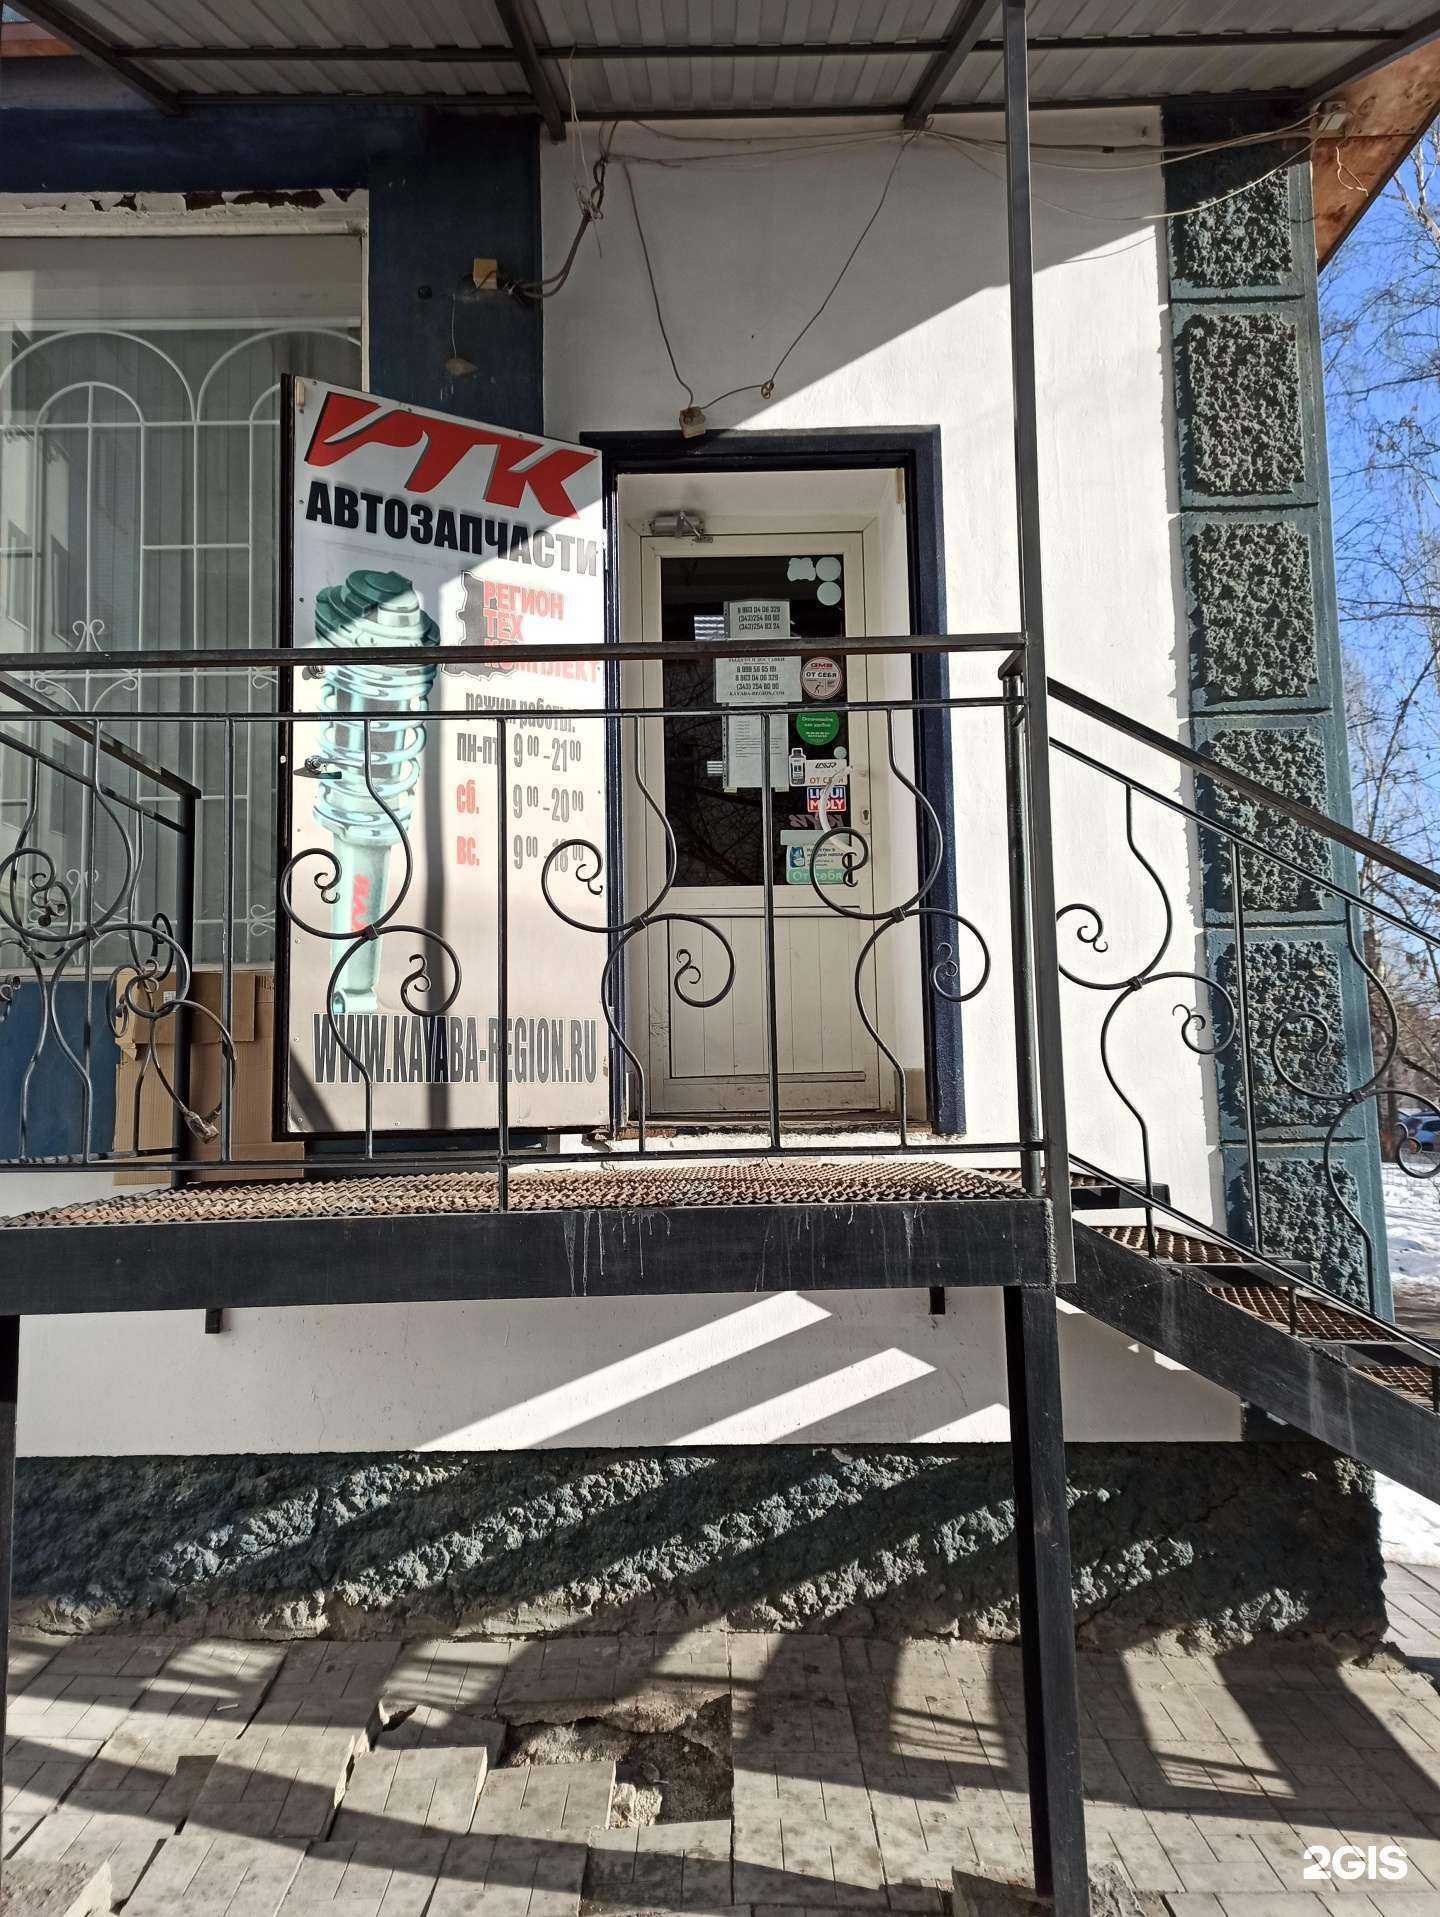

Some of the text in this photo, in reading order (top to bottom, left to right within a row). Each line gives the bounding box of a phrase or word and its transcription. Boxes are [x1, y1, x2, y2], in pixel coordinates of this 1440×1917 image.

[305, 480, 598, 577] АВТОЗАПЧАСТИ
[483, 579, 564, 620] РЕГИОН
[482, 608, 525, 642] ТЕХ
[809, 776, 844, 784] ОТ СЕЯ
[809, 788, 843, 799] LIUI
[312, 1012, 598, 1084] WWW.KAYABA-REGION.RU
